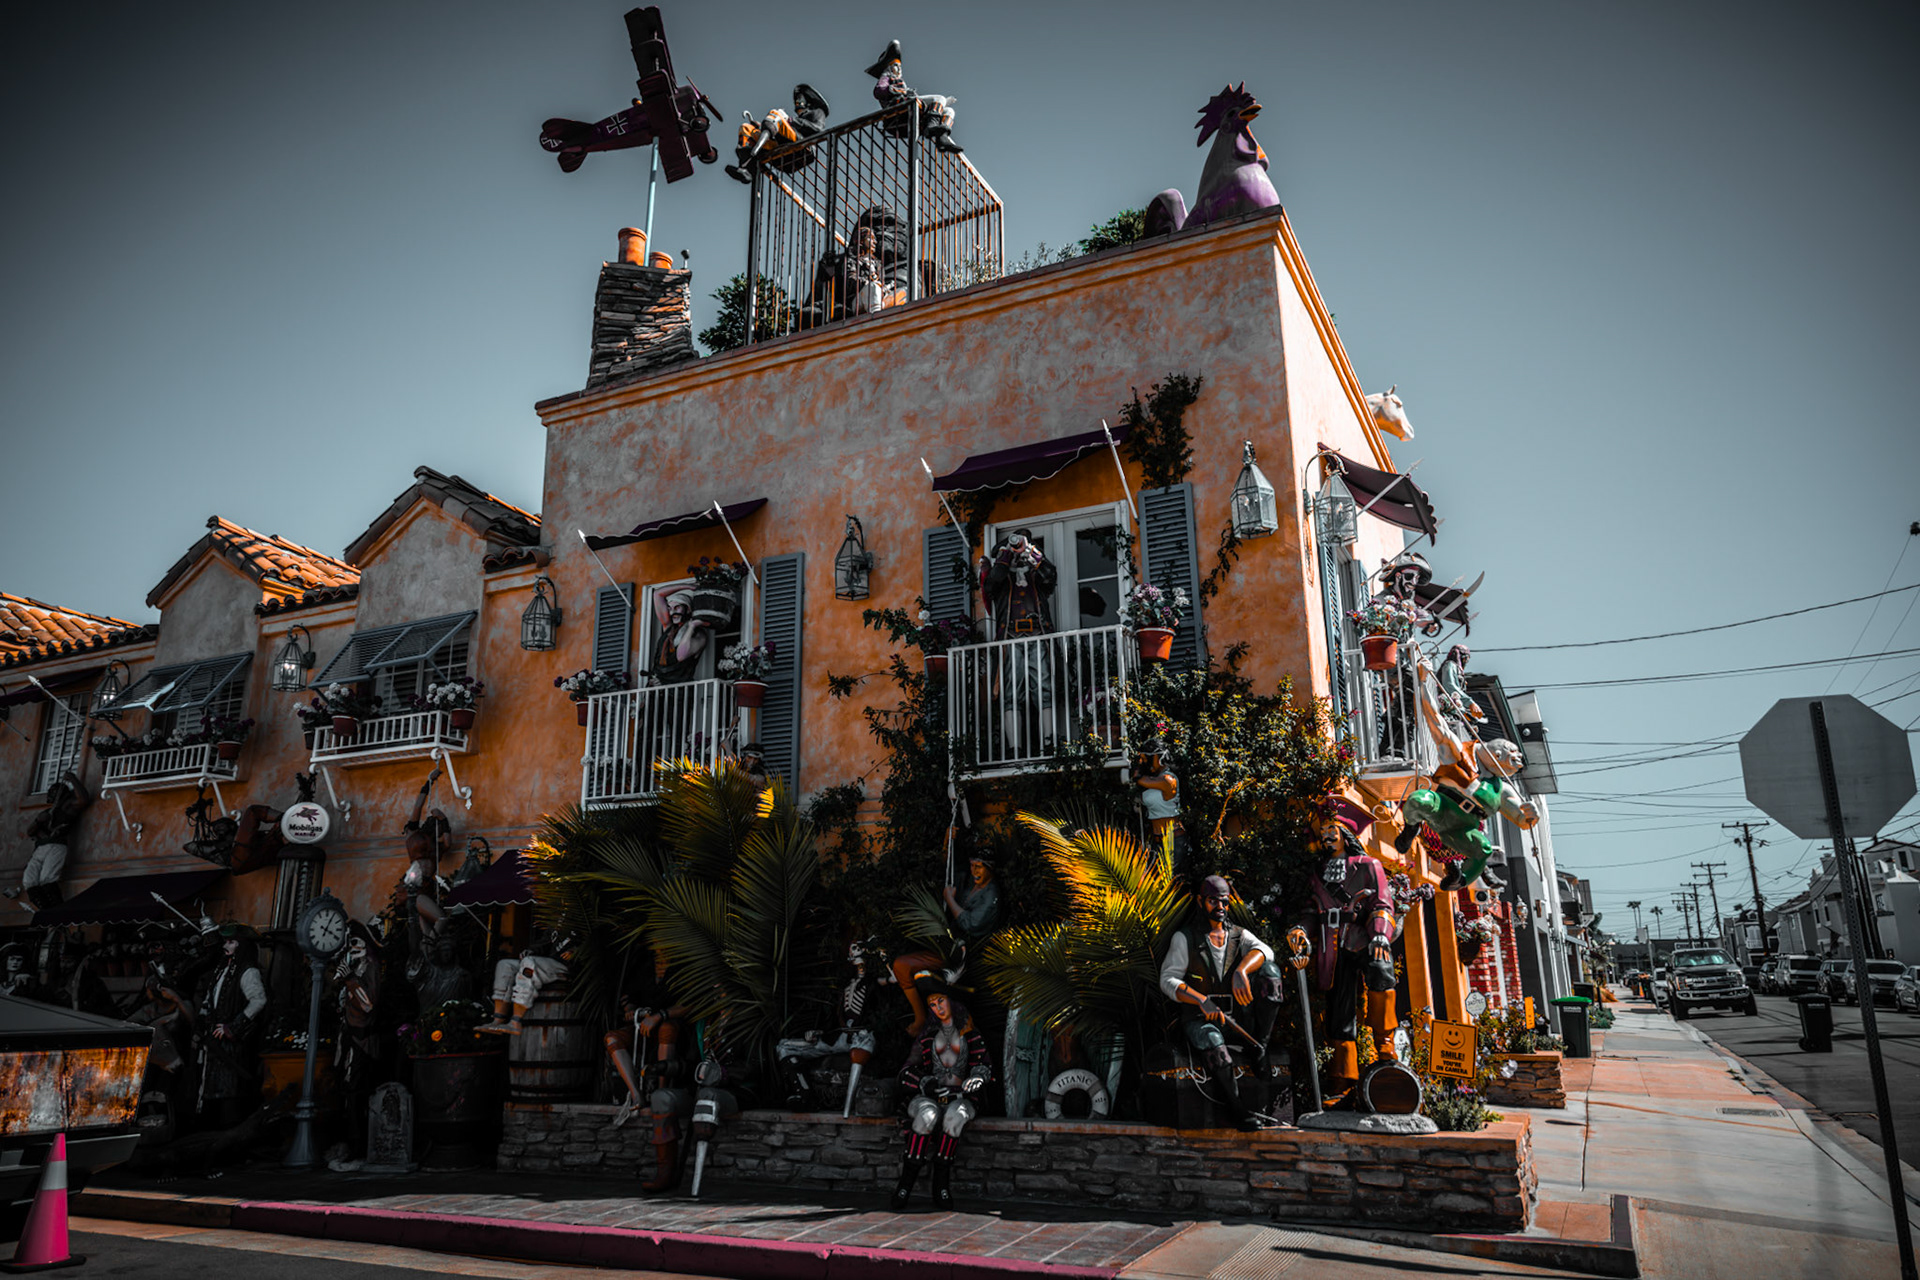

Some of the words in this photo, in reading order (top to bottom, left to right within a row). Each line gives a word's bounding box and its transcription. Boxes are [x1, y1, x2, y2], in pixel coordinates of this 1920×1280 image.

[289, 824, 323, 833] Mobilgas
[1441, 1050, 1465, 1060] SMILE!
[1445, 1066, 1467, 1074] CAMERA
[1056, 1076, 1092, 1088] TITANIC
